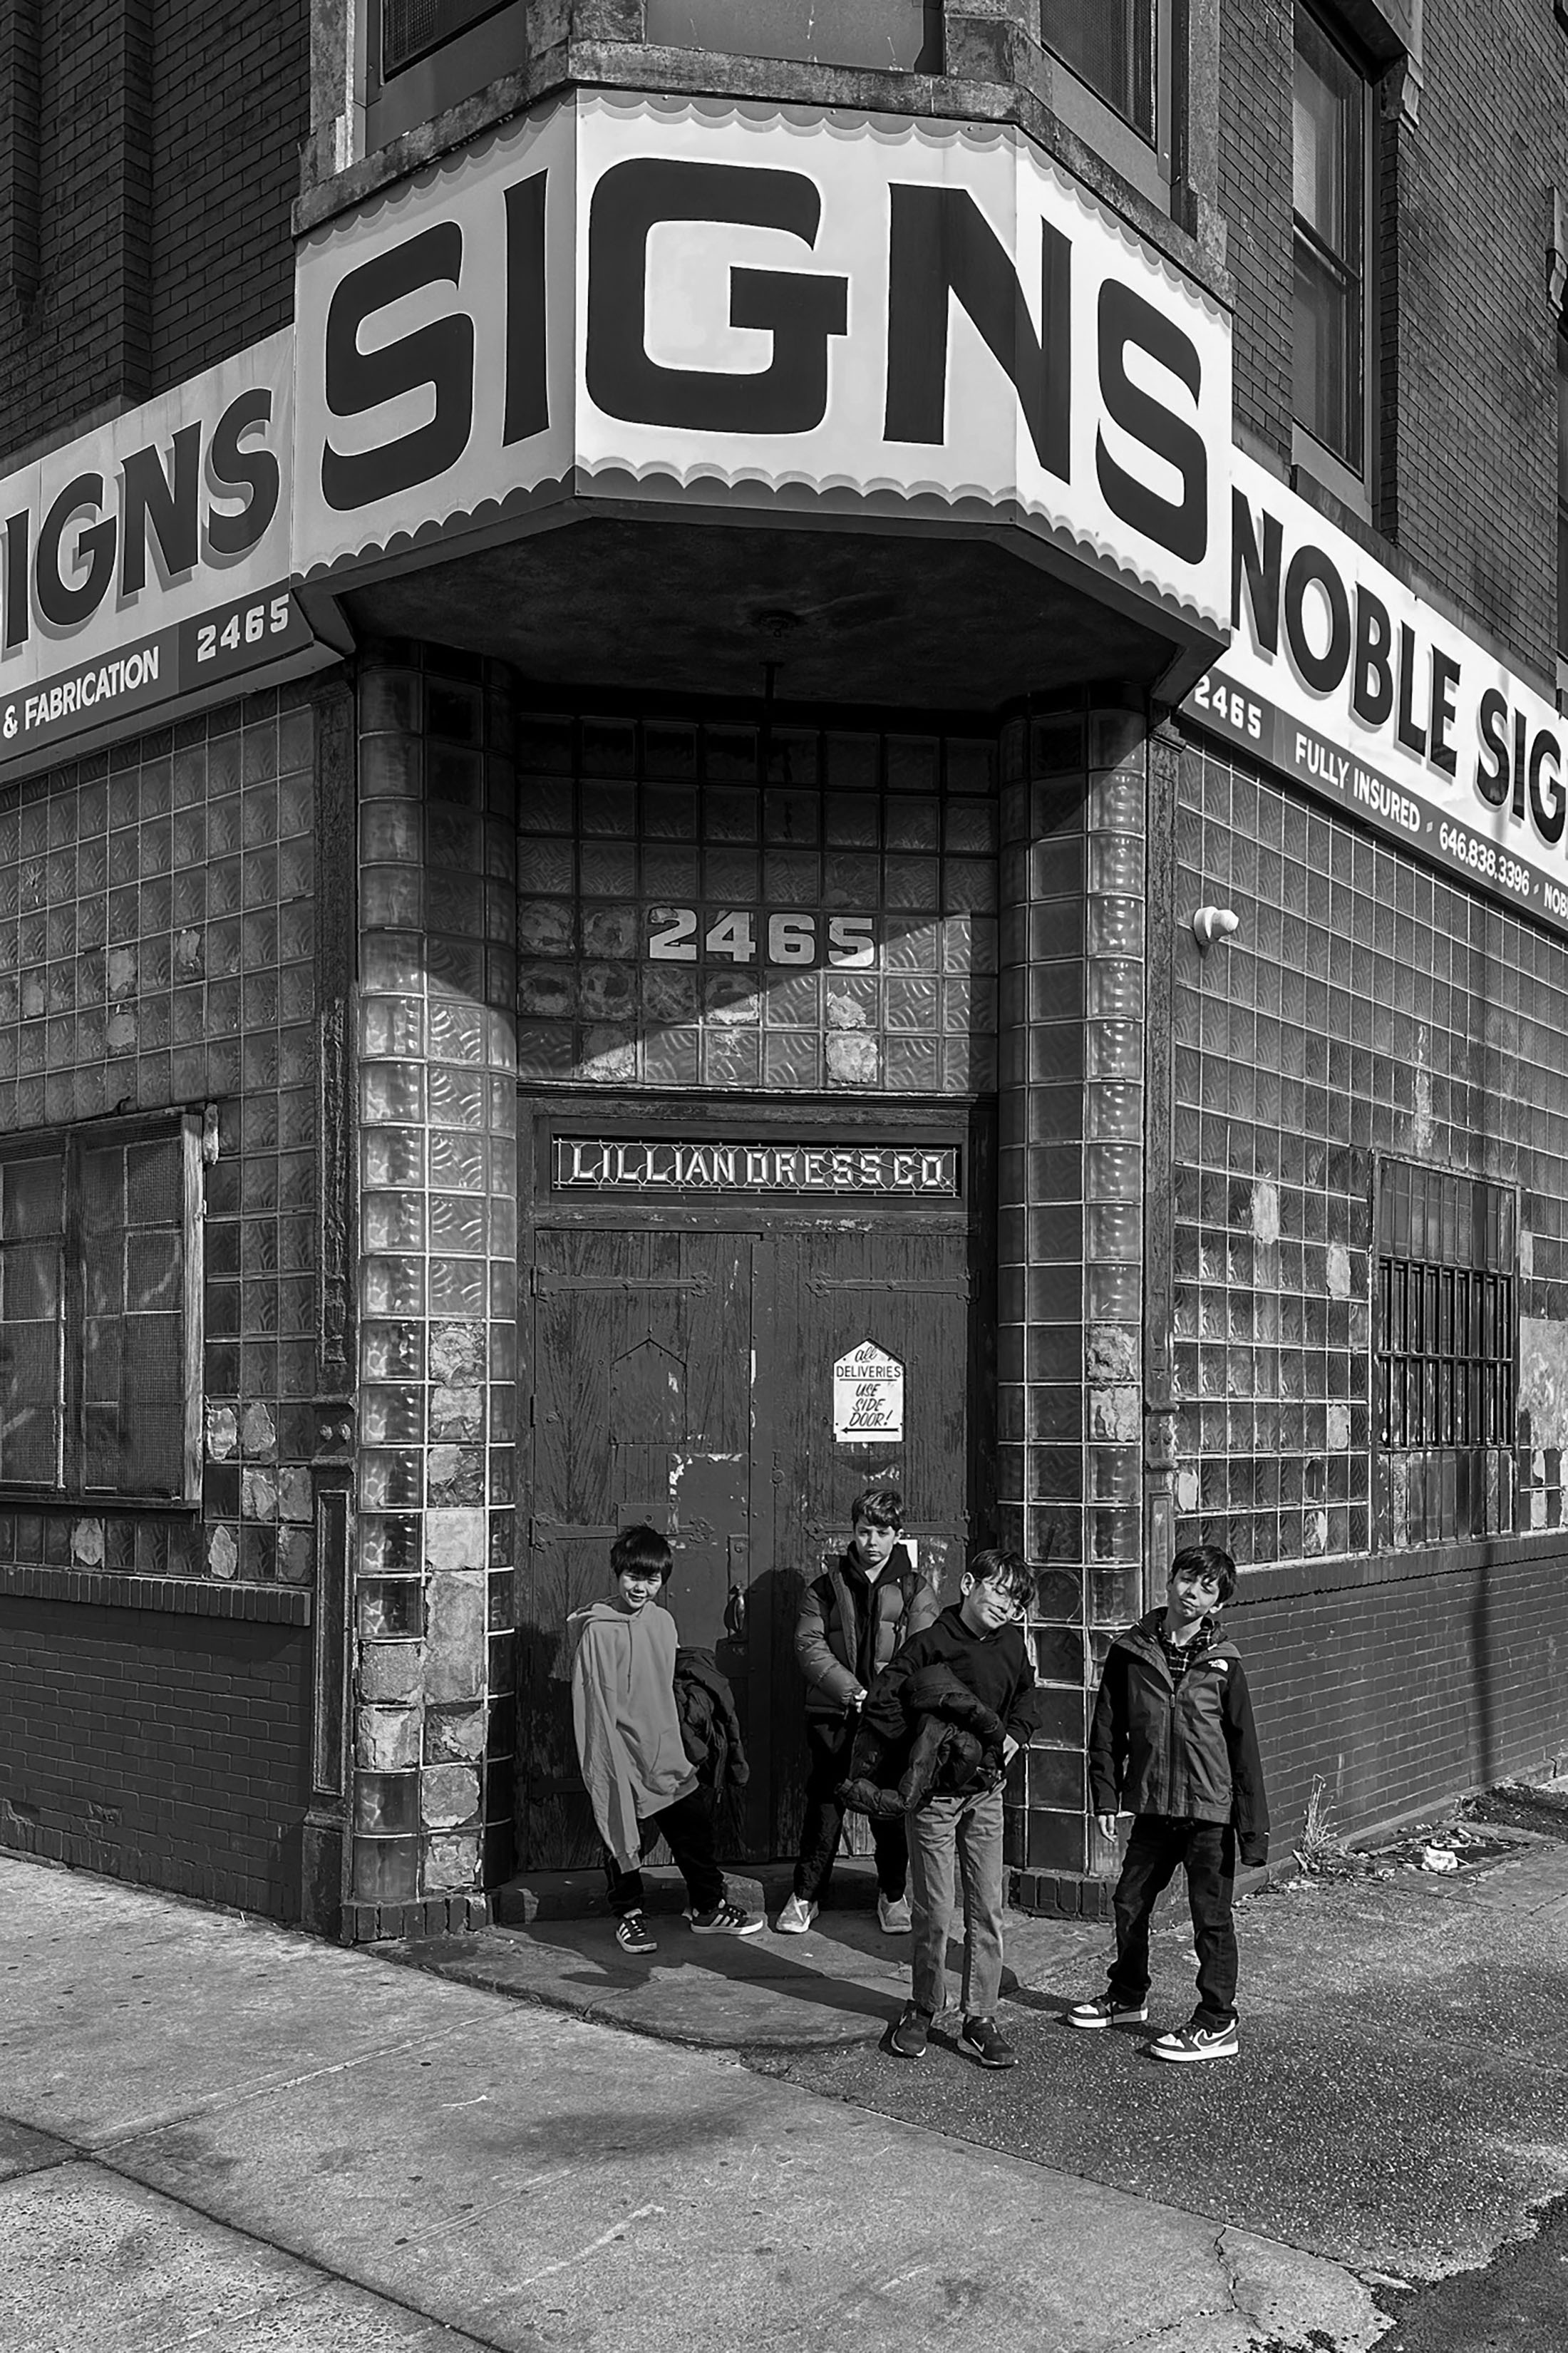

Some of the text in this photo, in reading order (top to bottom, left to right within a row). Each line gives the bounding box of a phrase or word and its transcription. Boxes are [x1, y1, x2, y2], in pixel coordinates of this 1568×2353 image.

[322, 157, 1207, 565] SIGNS
[6, 388, 280, 649] IGNS
[197, 594, 289, 664] 2465
[4, 646, 160, 738] & FABRICATION
[1232, 485, 1567, 844] NOBLE SIG
[1195, 674, 1262, 739] 2465
[1295, 732, 1568, 920] FULLY INSURED 646.838.3396 NOB
[648, 907, 875, 967] 2465
[573, 1147, 735, 1183] LILLIAN
[747, 1152, 881, 1185] DRESS
[836, 1366, 902, 1378] DELIVERIES
[855, 1346, 877, 1363] all
[849, 1409, 894, 1426] DOOR!
[852, 1398, 886, 1411] SIDE
[856, 1383, 881, 1397] USE
